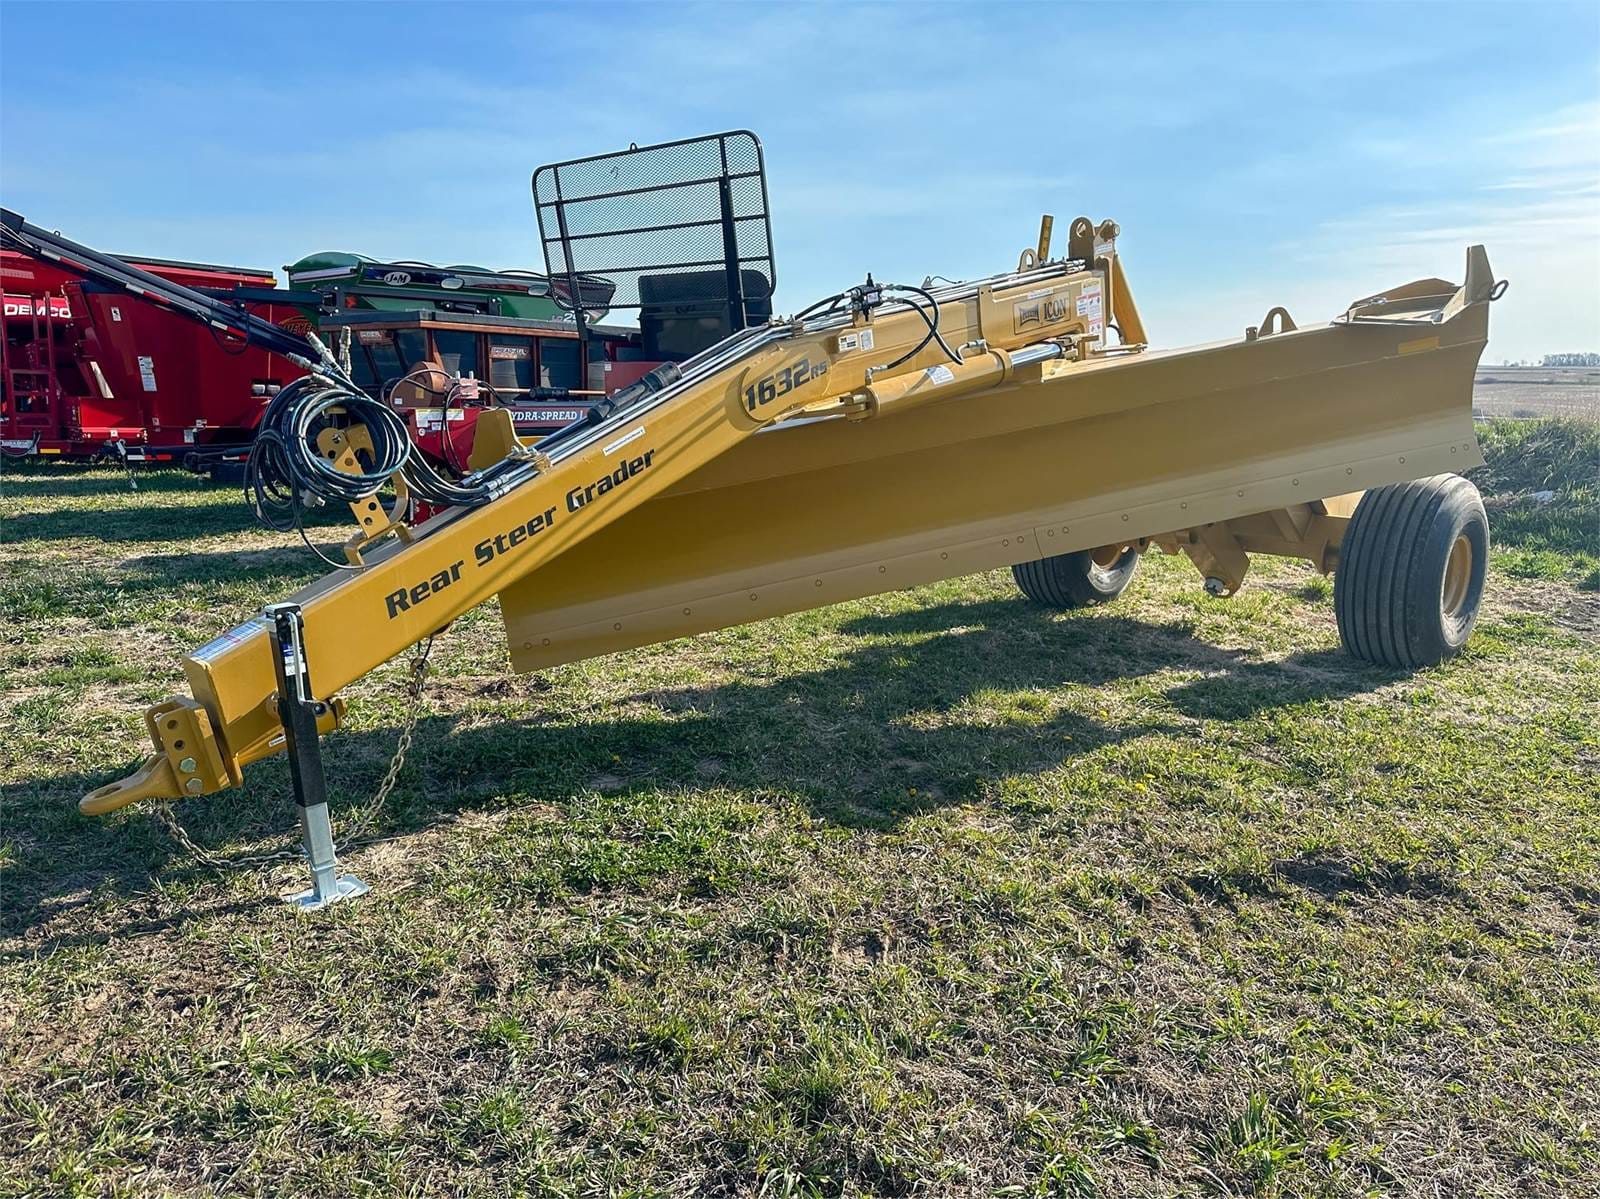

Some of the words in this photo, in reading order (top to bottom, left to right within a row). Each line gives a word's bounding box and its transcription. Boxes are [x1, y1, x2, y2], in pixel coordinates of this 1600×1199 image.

[385, 272, 410, 284] J&M
[4, 303, 72, 318] DEMCO
[1043, 298, 1067, 320] ICON
[511, 411, 578, 421] YDRA-SPREAD
[384, 560, 464, 619] Rear
[474, 505, 557, 567] Steer
[565, 448, 655, 513] Grader
